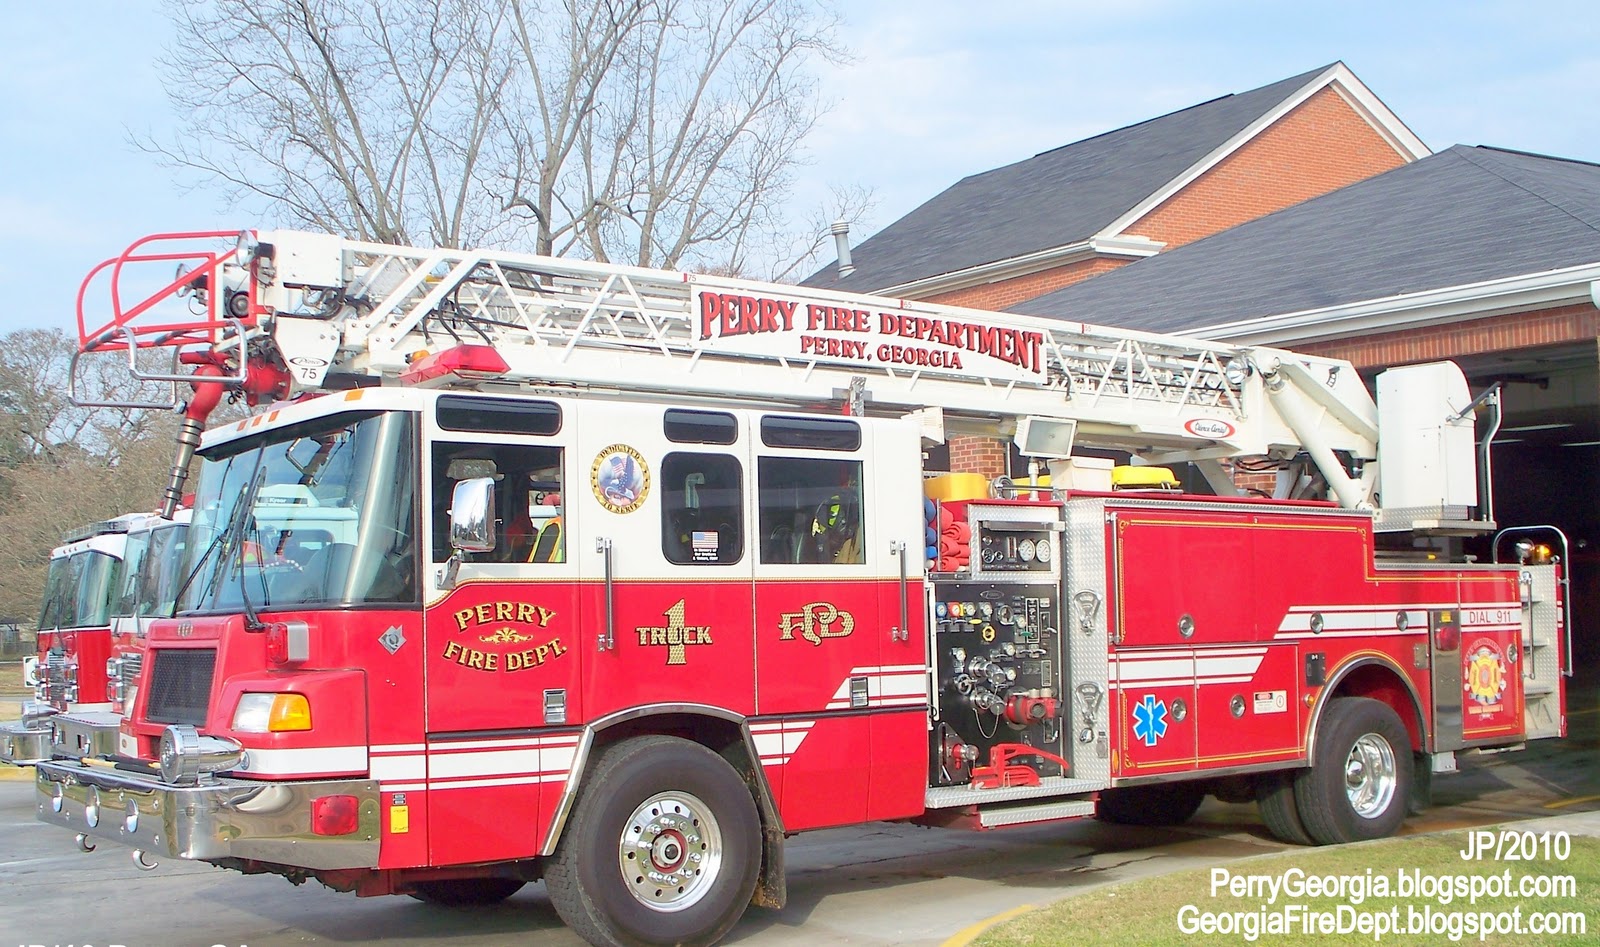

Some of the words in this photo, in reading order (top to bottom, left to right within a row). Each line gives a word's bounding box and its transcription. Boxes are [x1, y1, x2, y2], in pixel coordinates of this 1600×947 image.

[698, 291, 798, 340] PERRY
[806, 304, 870, 332] FIRE
[879, 313, 1044, 374] DEPARTMENT
[800, 334, 872, 362] PERRY,
[877, 343, 963, 369] GEORGIA
[301, 368, 317, 379] 75
[603, 501, 613, 510] TO
[616, 502, 639, 514] SERVE
[454, 601, 556, 631] PERRY
[1469, 611, 1491, 623] DIAL
[1496, 610, 1511, 622] 911
[634, 626, 713, 646] TRUCK
[662, 598, 687, 665] 1
[443, 640, 498, 671] FIRE
[505, 638, 567, 672] DEPT.
